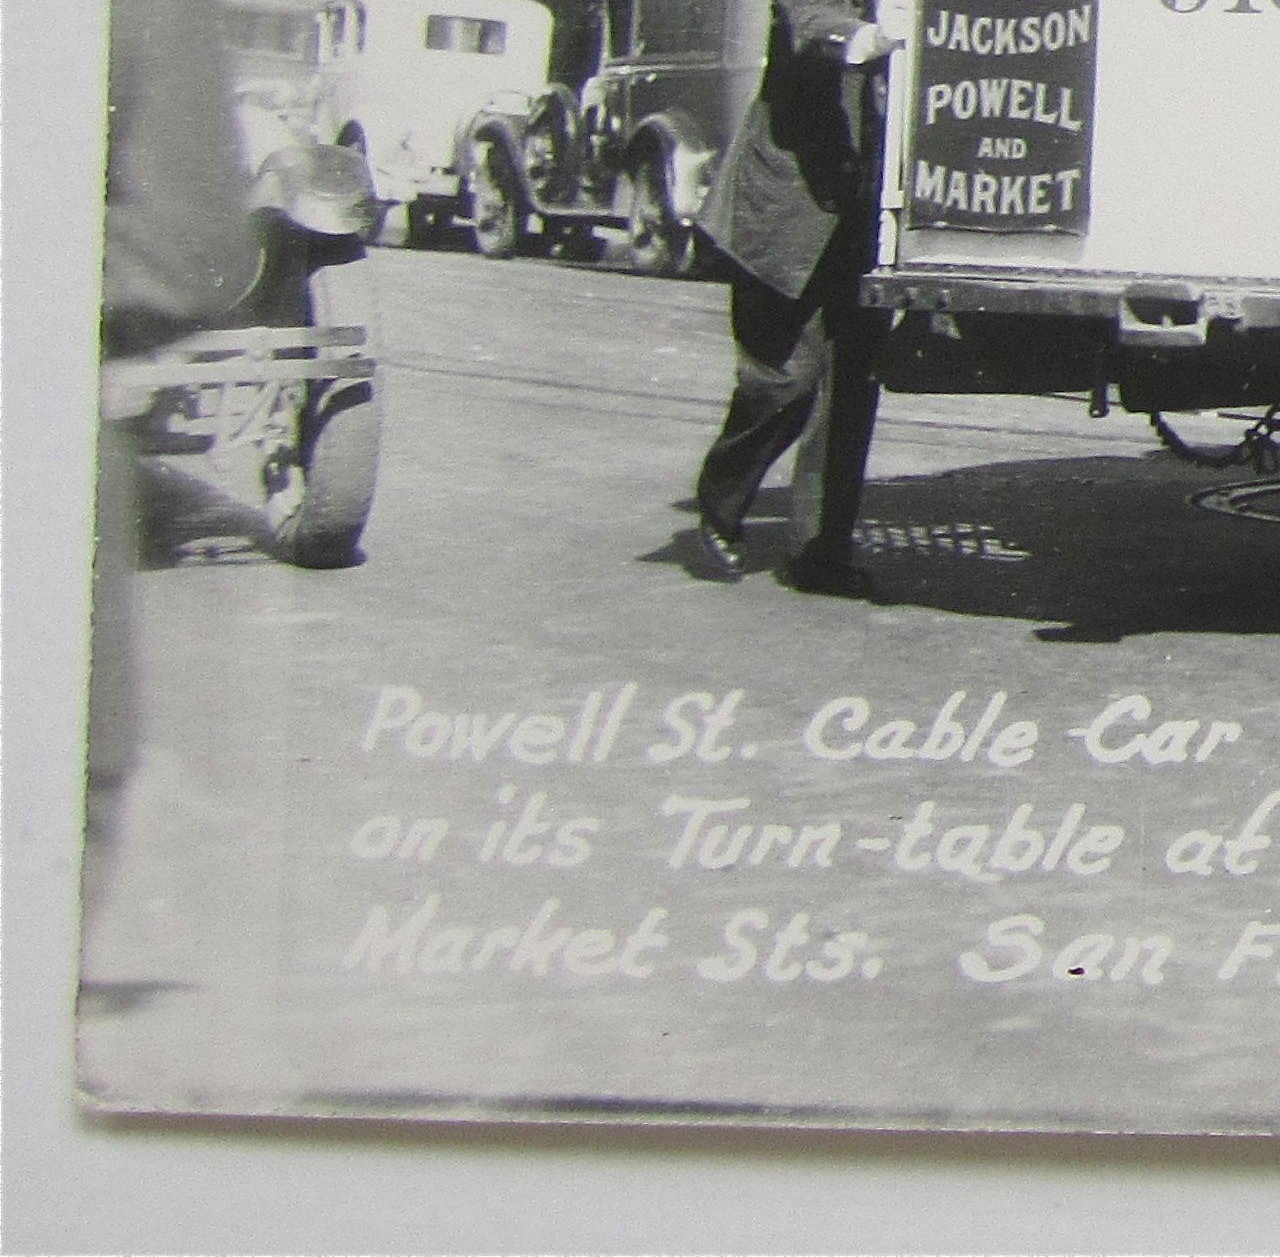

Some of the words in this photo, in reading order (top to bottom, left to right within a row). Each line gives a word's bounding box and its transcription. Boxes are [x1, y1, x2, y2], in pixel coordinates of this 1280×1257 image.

[926, 4, 1092, 55] JACKSON
[925, 78, 1083, 132] POWELL
[977, 136, 1028, 160] AND
[914, 160, 1082, 215] MARKET
